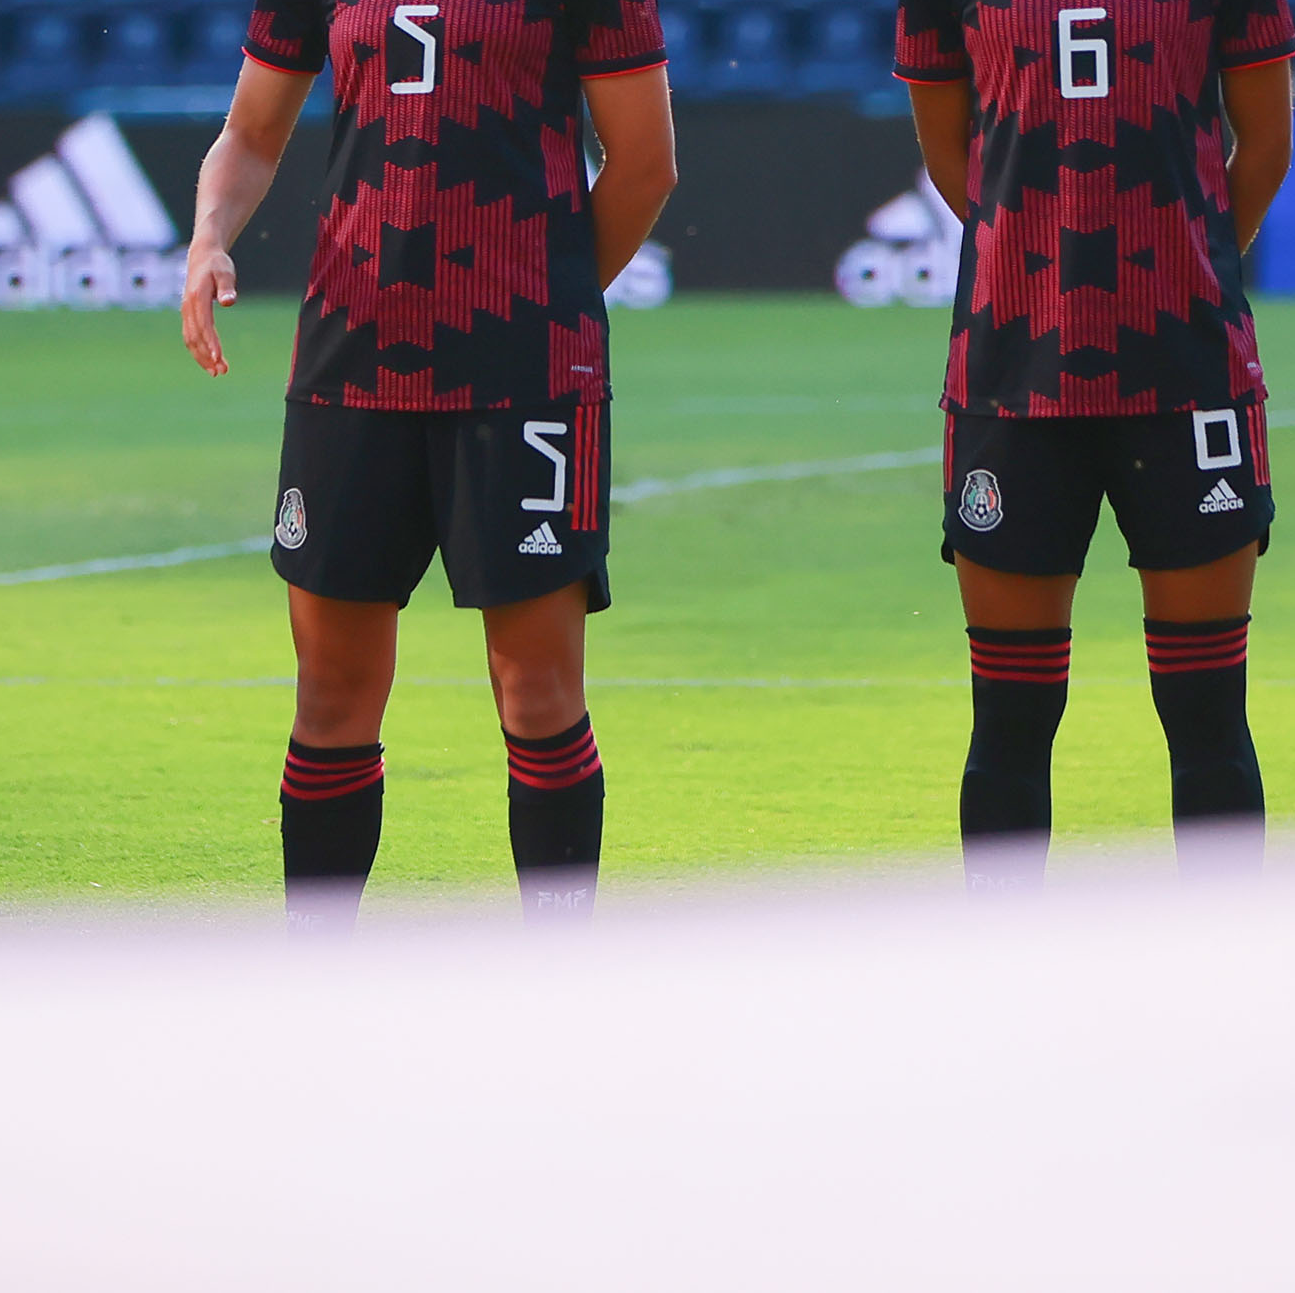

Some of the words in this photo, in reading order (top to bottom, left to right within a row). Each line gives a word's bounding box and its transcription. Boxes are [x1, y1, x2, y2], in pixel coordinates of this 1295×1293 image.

[390, 5, 440, 95] 5
[1058, 7, 1109, 99] 6
[520, 420, 568, 512] 5
[1198, 496, 1244, 514] adidas
[518, 541, 563, 555] adidas
